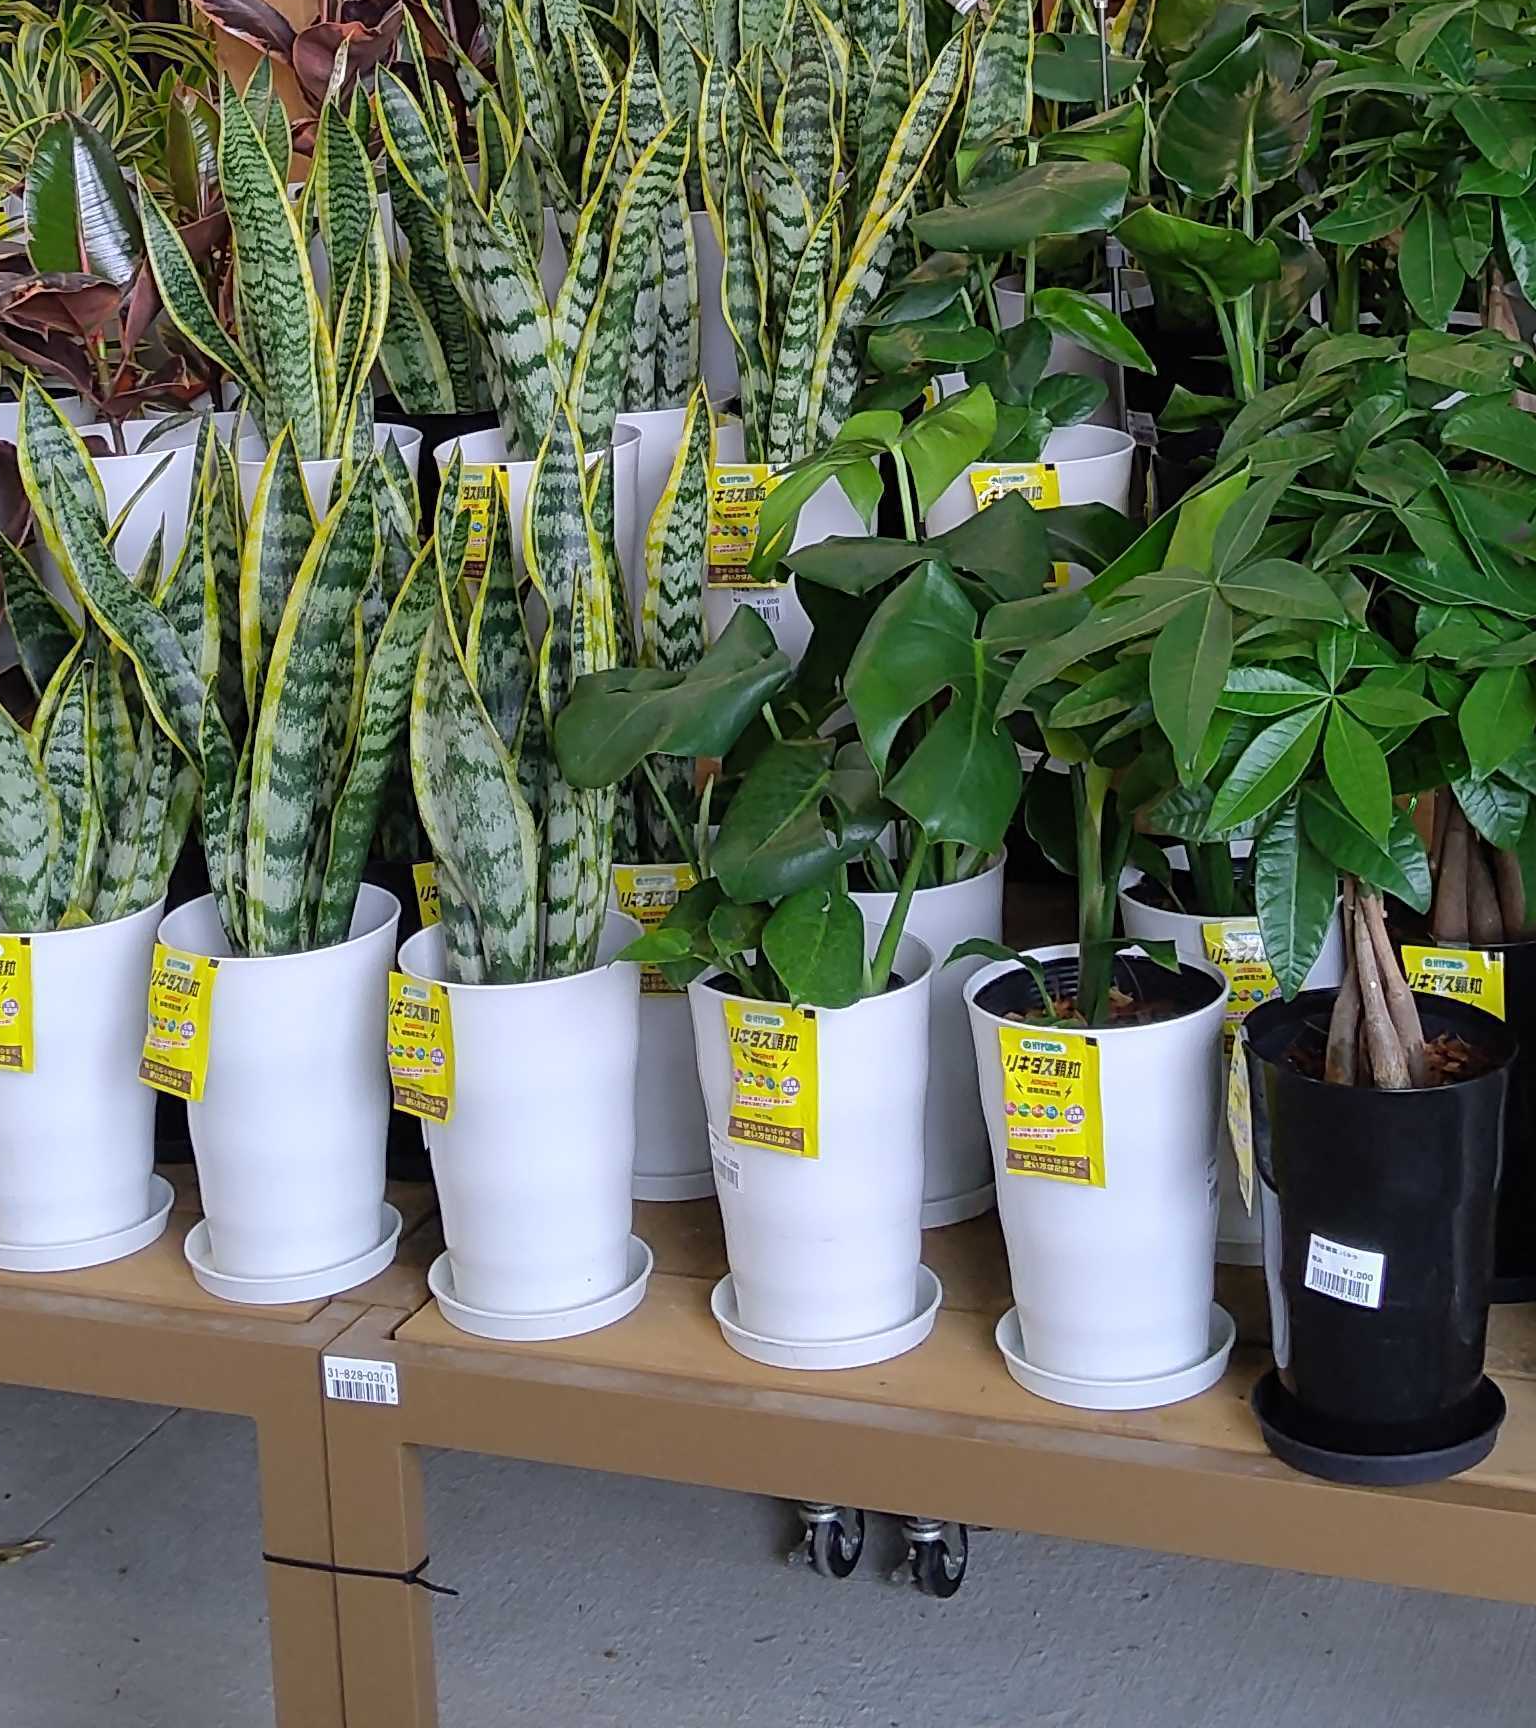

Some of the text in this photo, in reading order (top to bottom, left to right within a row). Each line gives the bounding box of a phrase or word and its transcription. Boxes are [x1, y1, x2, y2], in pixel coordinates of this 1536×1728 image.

[1407, 971, 1483, 995] リキダス顆粒
[730, 1026, 799, 1052] リキダス顆粒
[1005, 1054, 1082, 1080] リキダス顆粒
[327, 1366, 395, 1385] 31-828-03(1)
